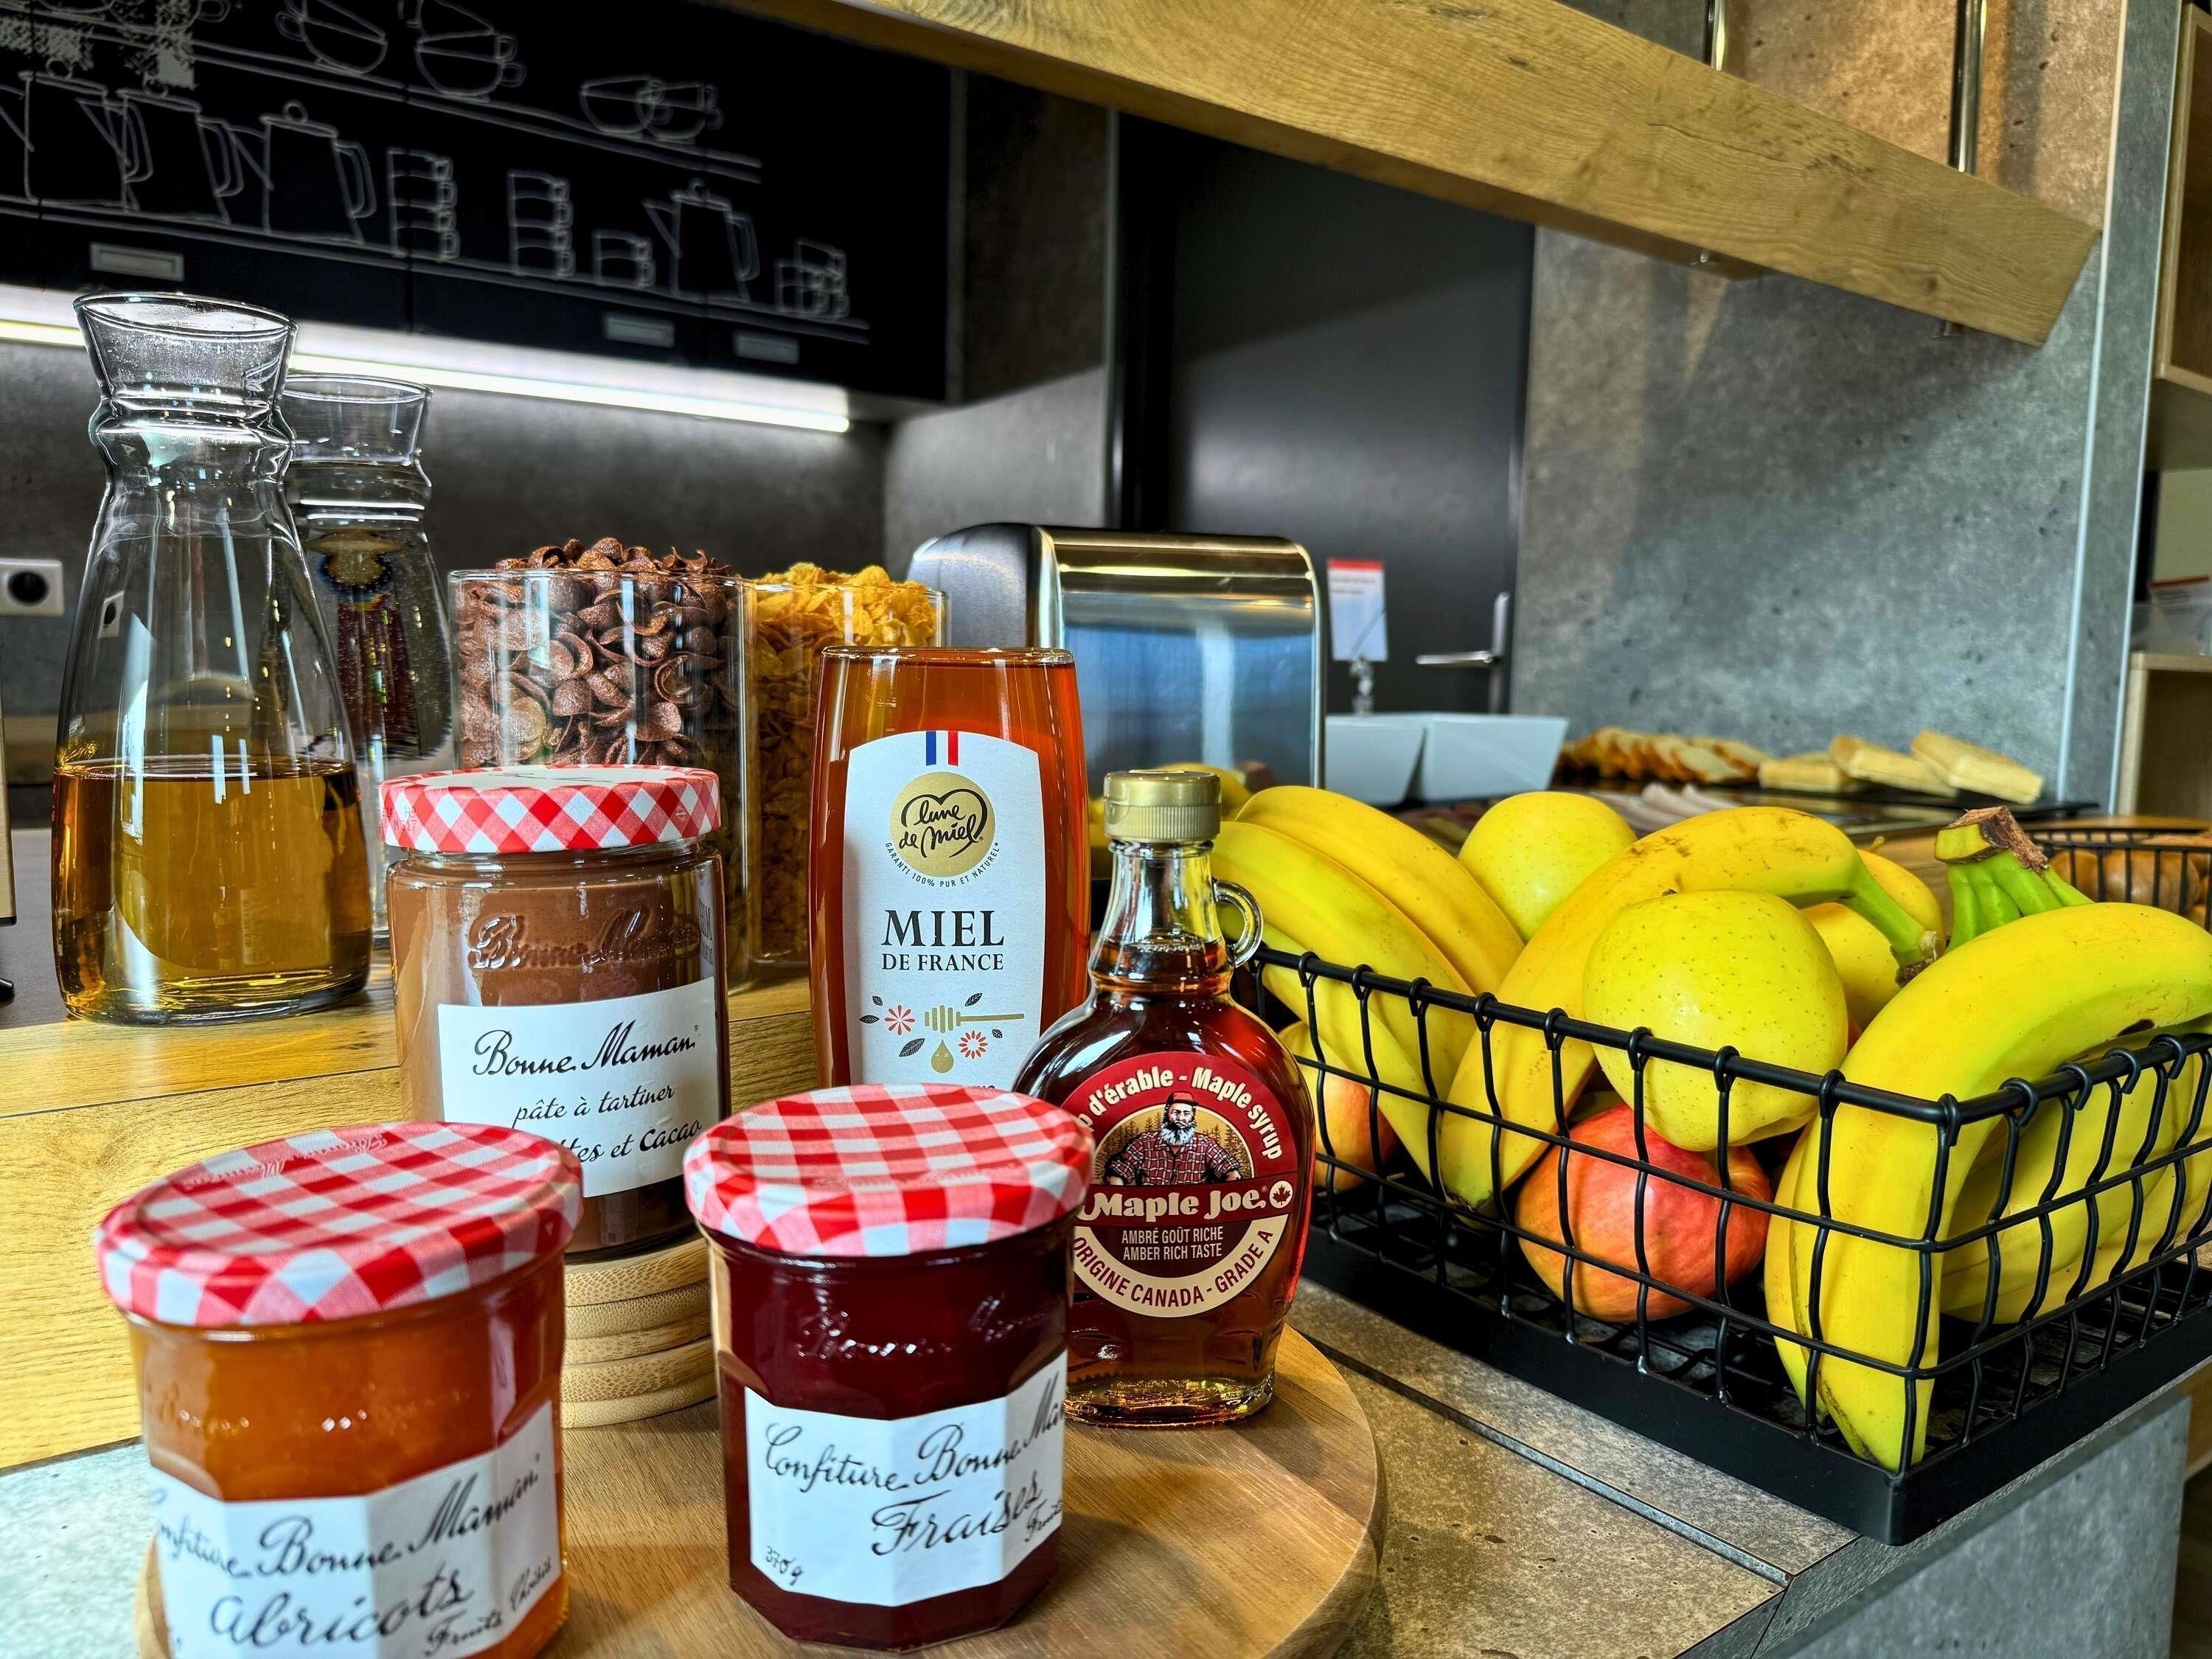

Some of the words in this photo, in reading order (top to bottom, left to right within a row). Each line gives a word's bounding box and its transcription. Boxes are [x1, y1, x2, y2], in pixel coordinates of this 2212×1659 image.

[914, 800, 966, 825] lune
[898, 831, 919, 849] de
[920, 813, 979, 858] miel
[885, 842, 911, 874] GARANTI
[911, 872, 935, 887] 100%
[959, 875, 970, 885] ET
[880, 909, 1005, 947] MIEL
[881, 953, 911, 971] DE
[917, 953, 1004, 971] FRANCE
[472, 1029, 576, 1077] Bonne
[581, 1019, 696, 1071] Maman
[512, 1096, 568, 1129] pâte
[573, 1096, 590, 1116] à
[598, 1085, 675, 1114] tartiner
[1088, 1065, 1174, 1118] d'érable
[1191, 1067, 1253, 1109] Maple
[1248, 1104, 1283, 1161] syrup
[611, 1133, 635, 1159] et
[639, 1119, 703, 1152] Cacao
[1076, 1192, 1200, 1222] Maple
[1121, 1226, 1159, 1245] AMBRÉ
[1161, 1225, 1192, 1244] GOÛT
[1193, 1226, 1224, 1241] RICHE
[1123, 1246, 1161, 1261] AMBER
[1164, 1245, 1189, 1260] RICH
[1191, 1243, 1222, 1258] TASTE
[1073, 1236, 1132, 1298] ORIGINE
[1130, 1284, 1205, 1308] CANADA
[1214, 1243, 1265, 1294] GRADE
[1259, 1229, 1274, 1244] A
[765, 1422, 910, 1493] Confiture
[915, 1424, 1022, 1485] Bonne
[257, 1514, 401, 1579] Bonne
[407, 1471, 540, 1553] Maman
[872, 1470, 1043, 1557] Fraises
